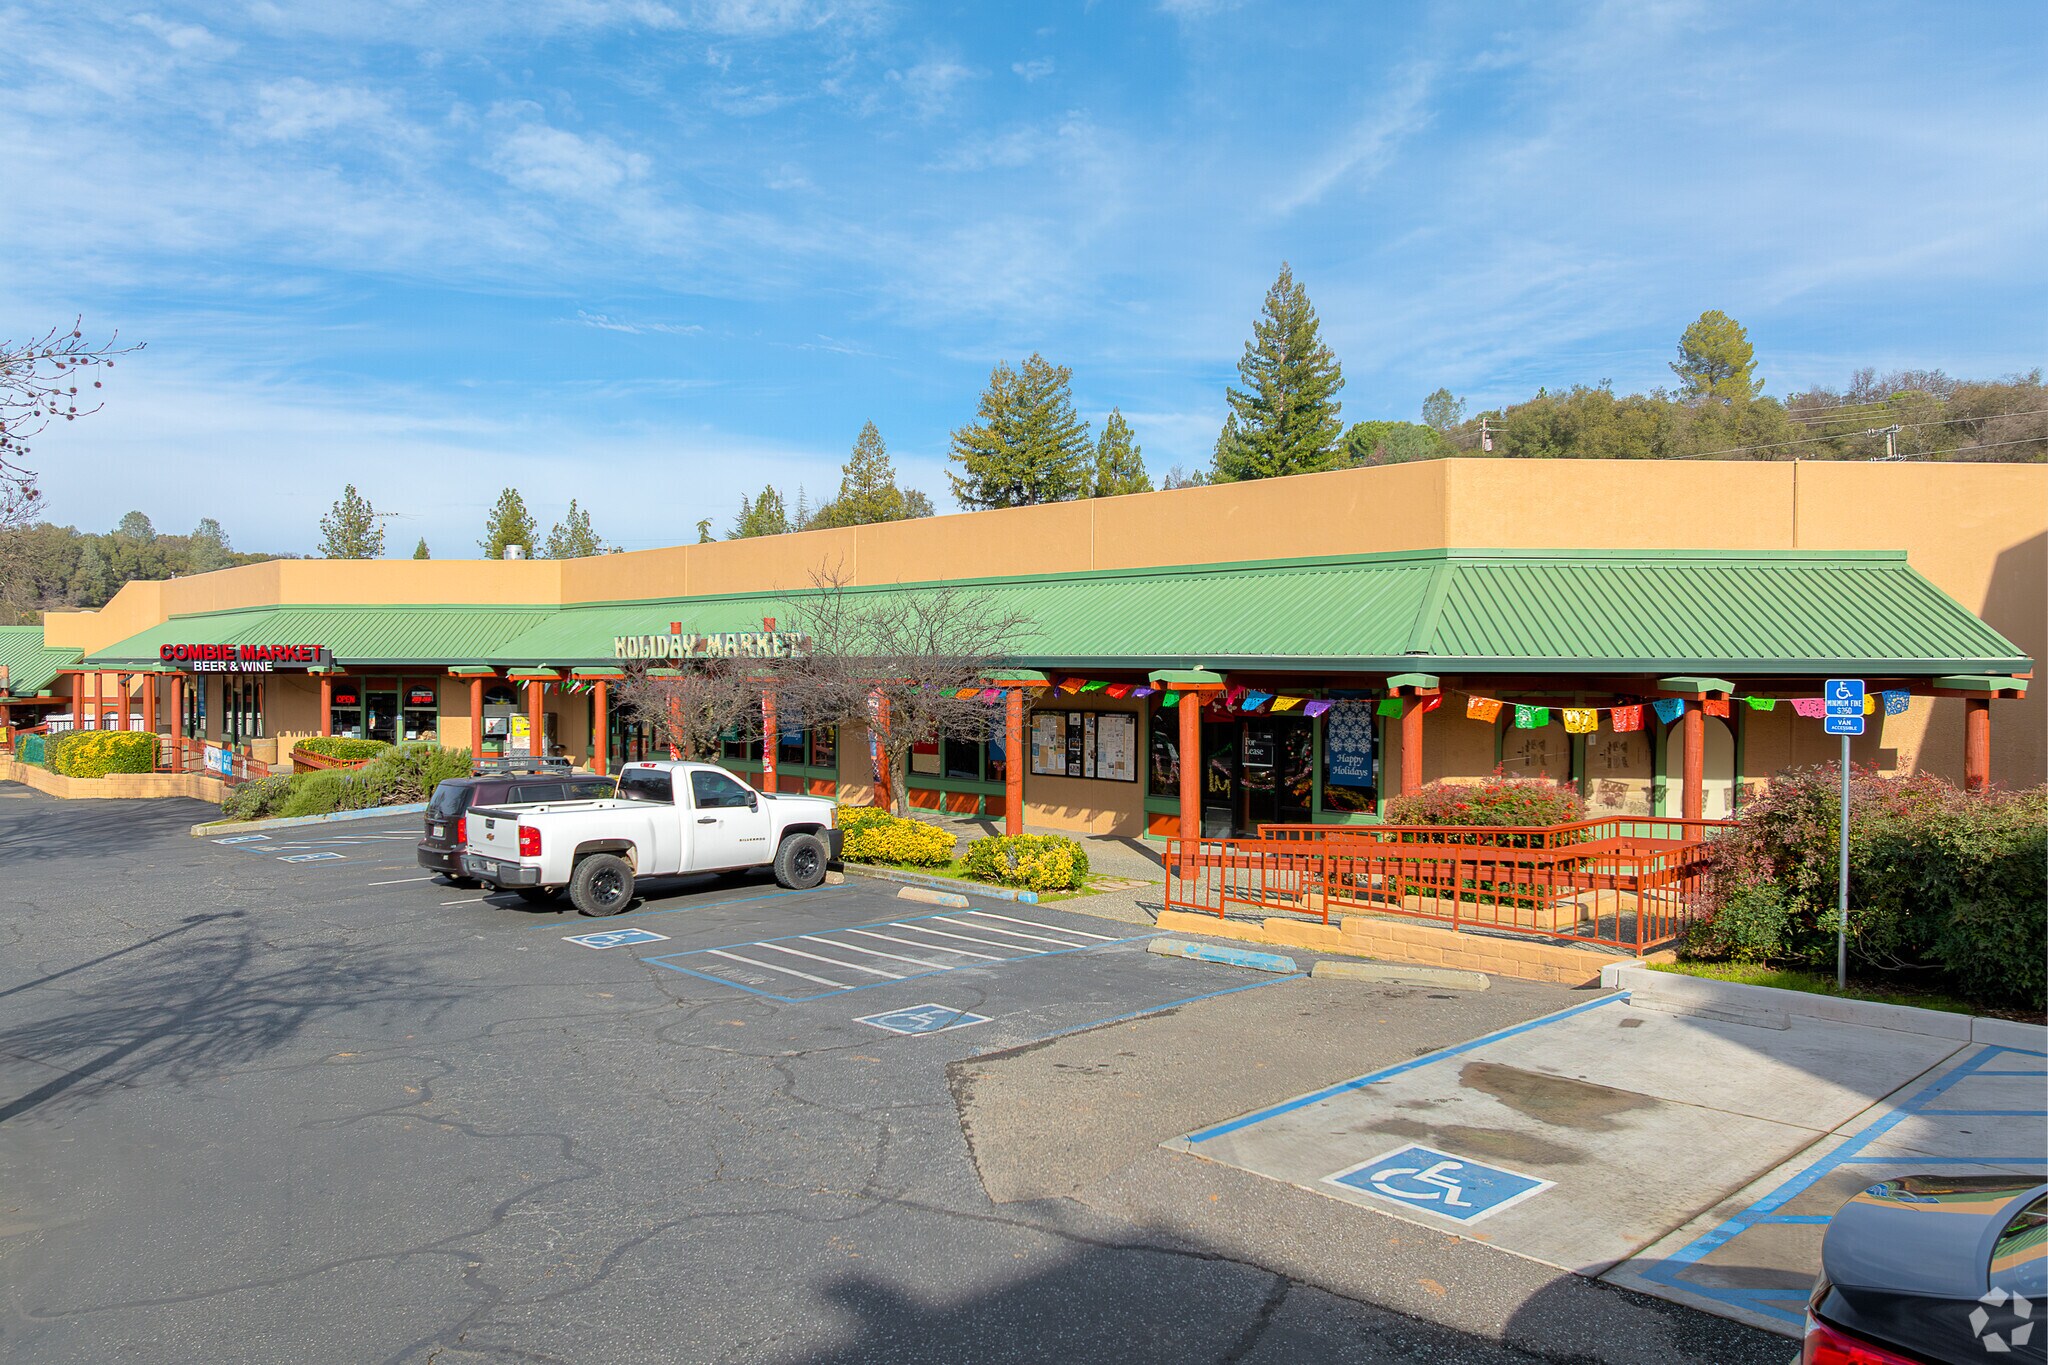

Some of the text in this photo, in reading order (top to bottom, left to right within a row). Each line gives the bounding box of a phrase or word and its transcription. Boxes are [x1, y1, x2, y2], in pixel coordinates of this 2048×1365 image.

[614, 631, 803, 658] HOLIDAY MARKET
[160, 643, 323, 661] COMBIE MARKET
[193, 661, 273, 672] BEER & WINE
[336, 695, 355, 703] OPEN
[1244, 737, 1257, 746] For
[1244, 745, 1264, 756] Lease
[1336, 754, 1363, 766] Happy
[1332, 766, 1368, 779] Holidays
